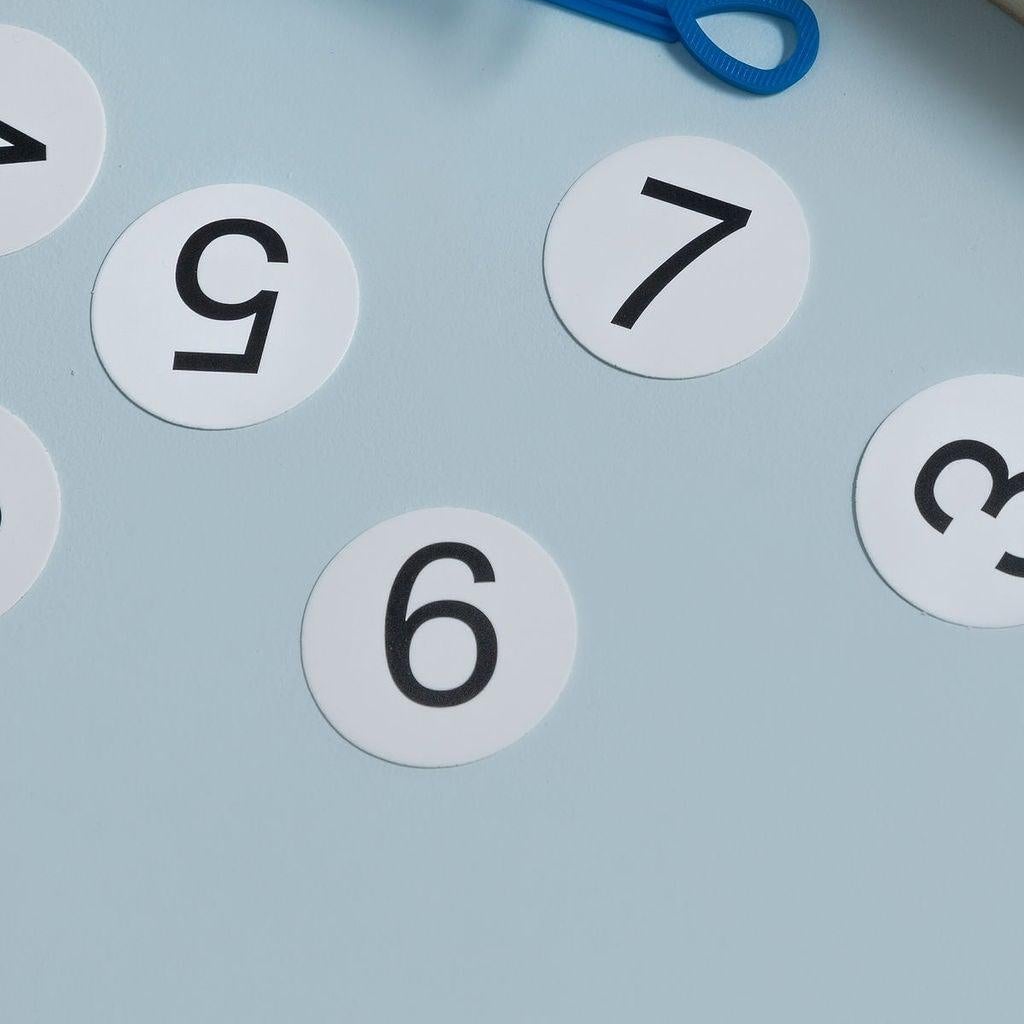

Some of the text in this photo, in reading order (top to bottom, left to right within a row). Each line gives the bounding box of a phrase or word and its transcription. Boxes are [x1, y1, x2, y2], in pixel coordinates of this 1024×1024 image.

[172, 218, 289, 374] 5
[610, 176, 753, 330] 7
[384, 541, 498, 708] 6
